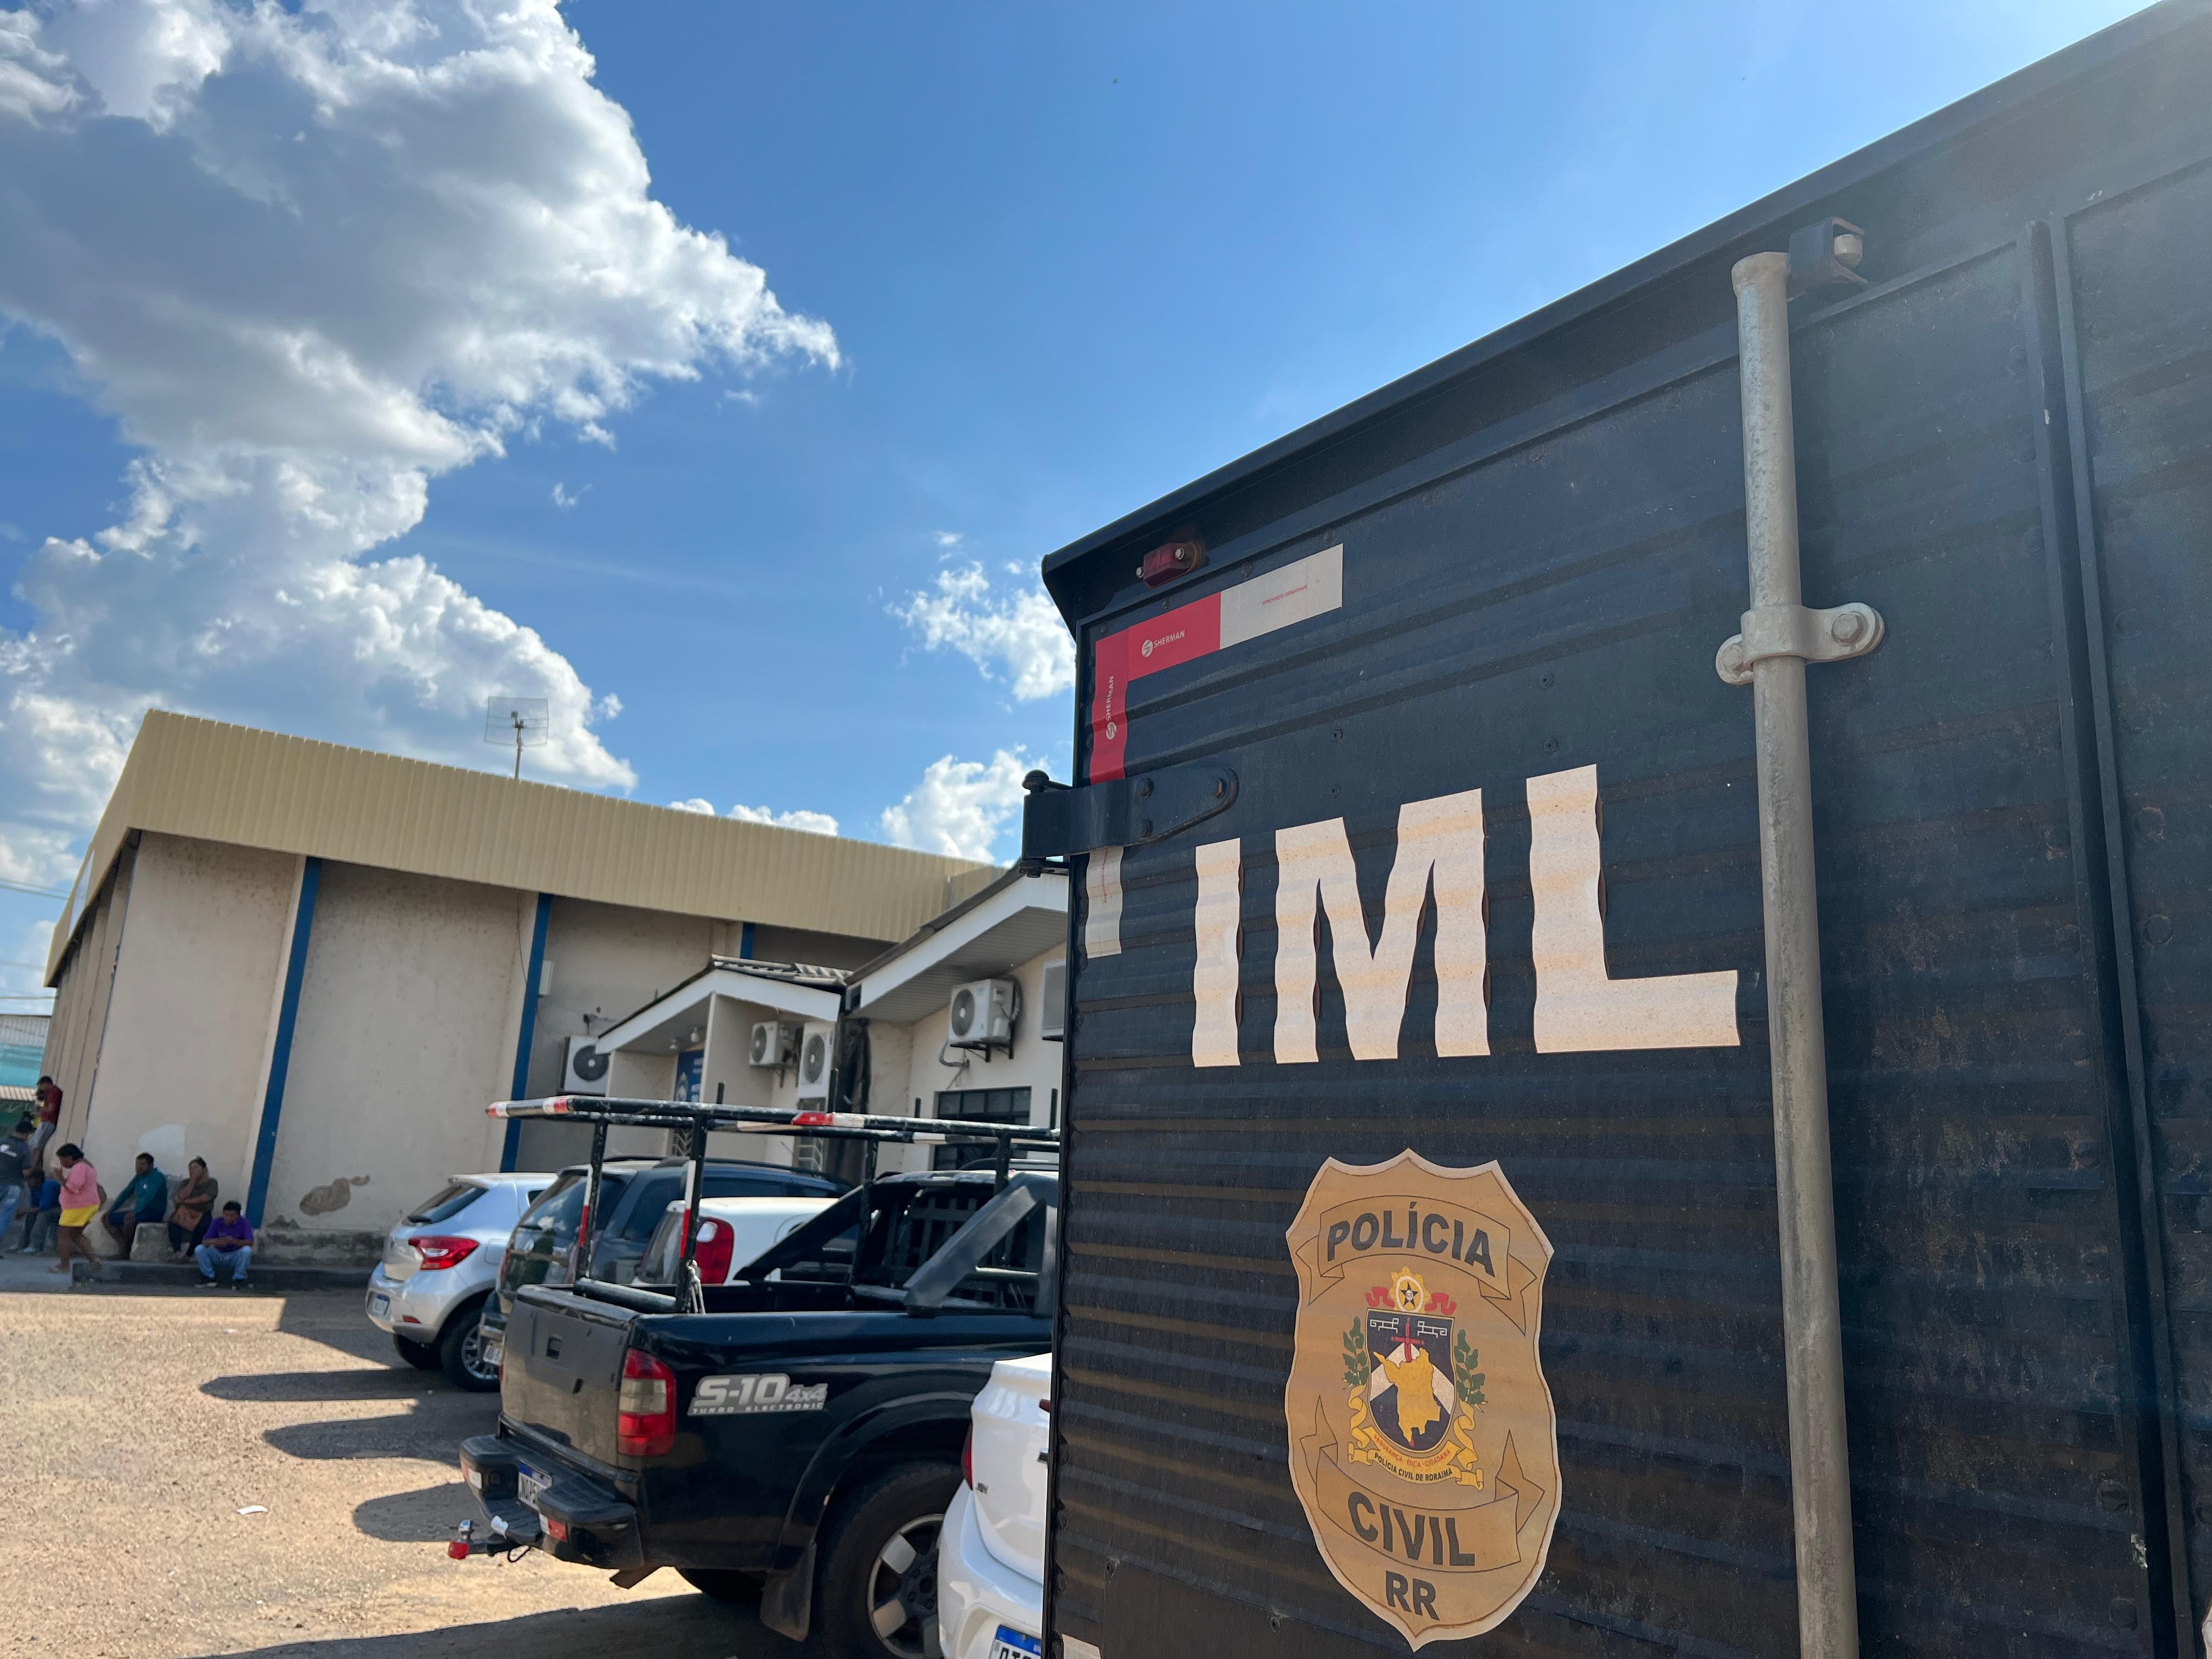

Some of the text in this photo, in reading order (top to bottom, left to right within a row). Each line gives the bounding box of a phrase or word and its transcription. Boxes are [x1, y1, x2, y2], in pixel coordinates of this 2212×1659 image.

[1153, 629, 1185, 648] SHERMAN
[1105, 675, 1114, 721] SHERMAN
[1192, 764, 1741, 1068] IML
[1327, 1201, 1496, 1278] POLÍCIA
[693, 1375, 788, 1407] S-10
[1373, 1434, 1452, 1468] SEGURANÇA ÉTICA CIDADANIA
[1374, 1452, 1397, 1474] POLÍCIA
[1398, 1468, 1414, 1480] CIVIL
[1425, 1468, 1453, 1481] RORAIMA
[1347, 1491, 1475, 1566] CIVIL
[1385, 1570, 1441, 1621] RR
